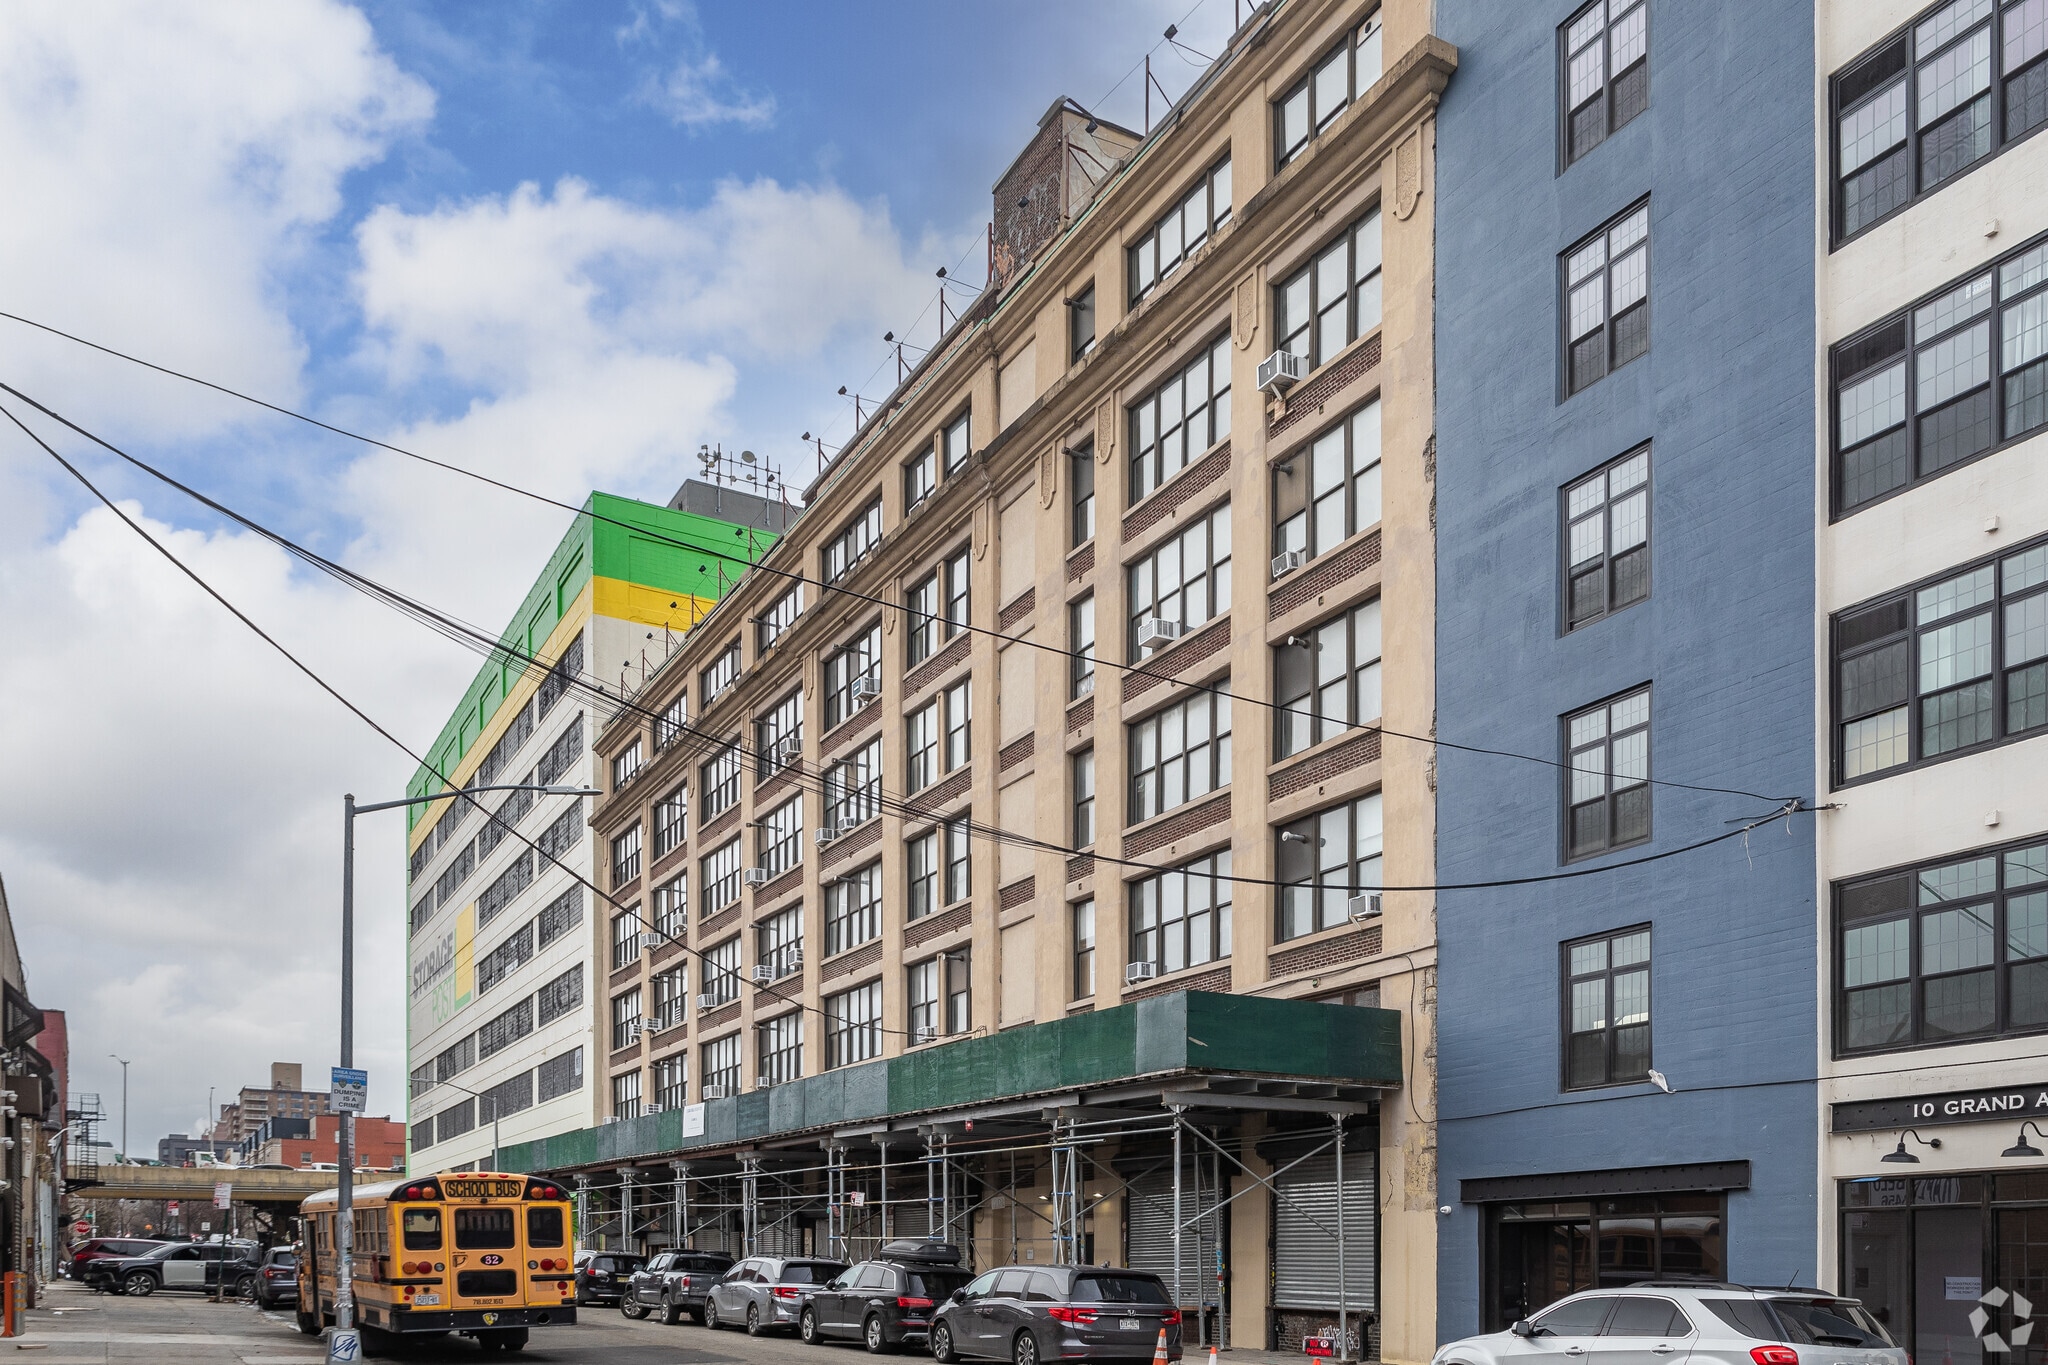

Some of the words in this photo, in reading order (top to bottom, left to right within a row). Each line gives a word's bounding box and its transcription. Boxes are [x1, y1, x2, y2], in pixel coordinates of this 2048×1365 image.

[413, 931, 454, 1000] STORAGE
[432, 974, 454, 1028] POST
[334, 1089, 365, 1097] DUMPING
[1913, 1102, 1935, 1118] 10
[1943, 1094, 2025, 1115] GRAND
[448, 1181, 494, 1197] SCHOOL
[496, 1181, 518, 1196] BUS
[484, 1255, 499, 1265] 32
[1310, 1339, 1318, 1347] NO
[1306, 1348, 1332, 1356] PARKING
